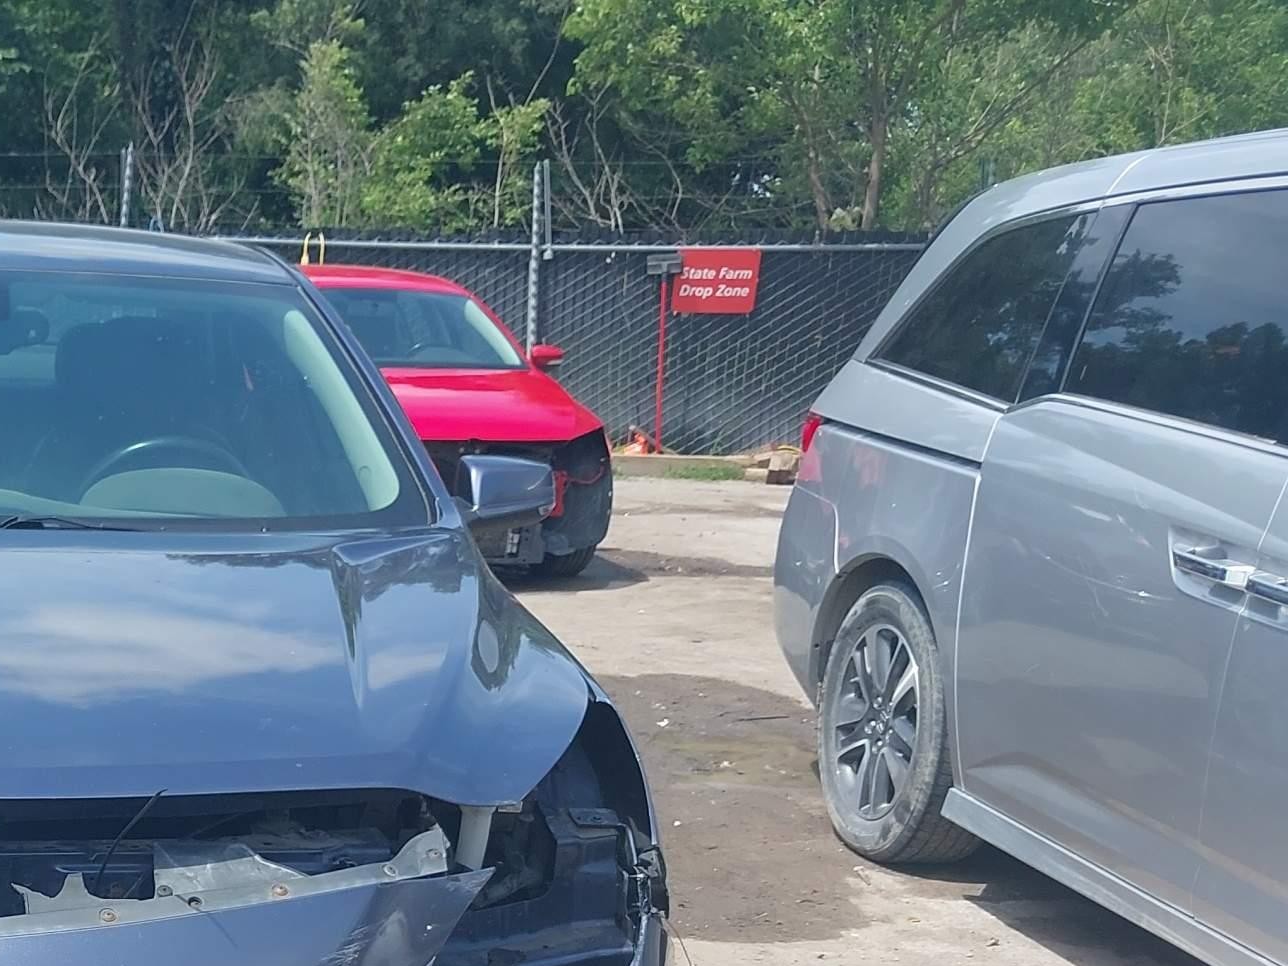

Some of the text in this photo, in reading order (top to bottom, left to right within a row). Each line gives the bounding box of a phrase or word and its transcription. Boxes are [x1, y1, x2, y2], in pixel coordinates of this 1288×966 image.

[680, 266, 753, 279] State Farm
[679, 284, 750, 299] Drop Zone
